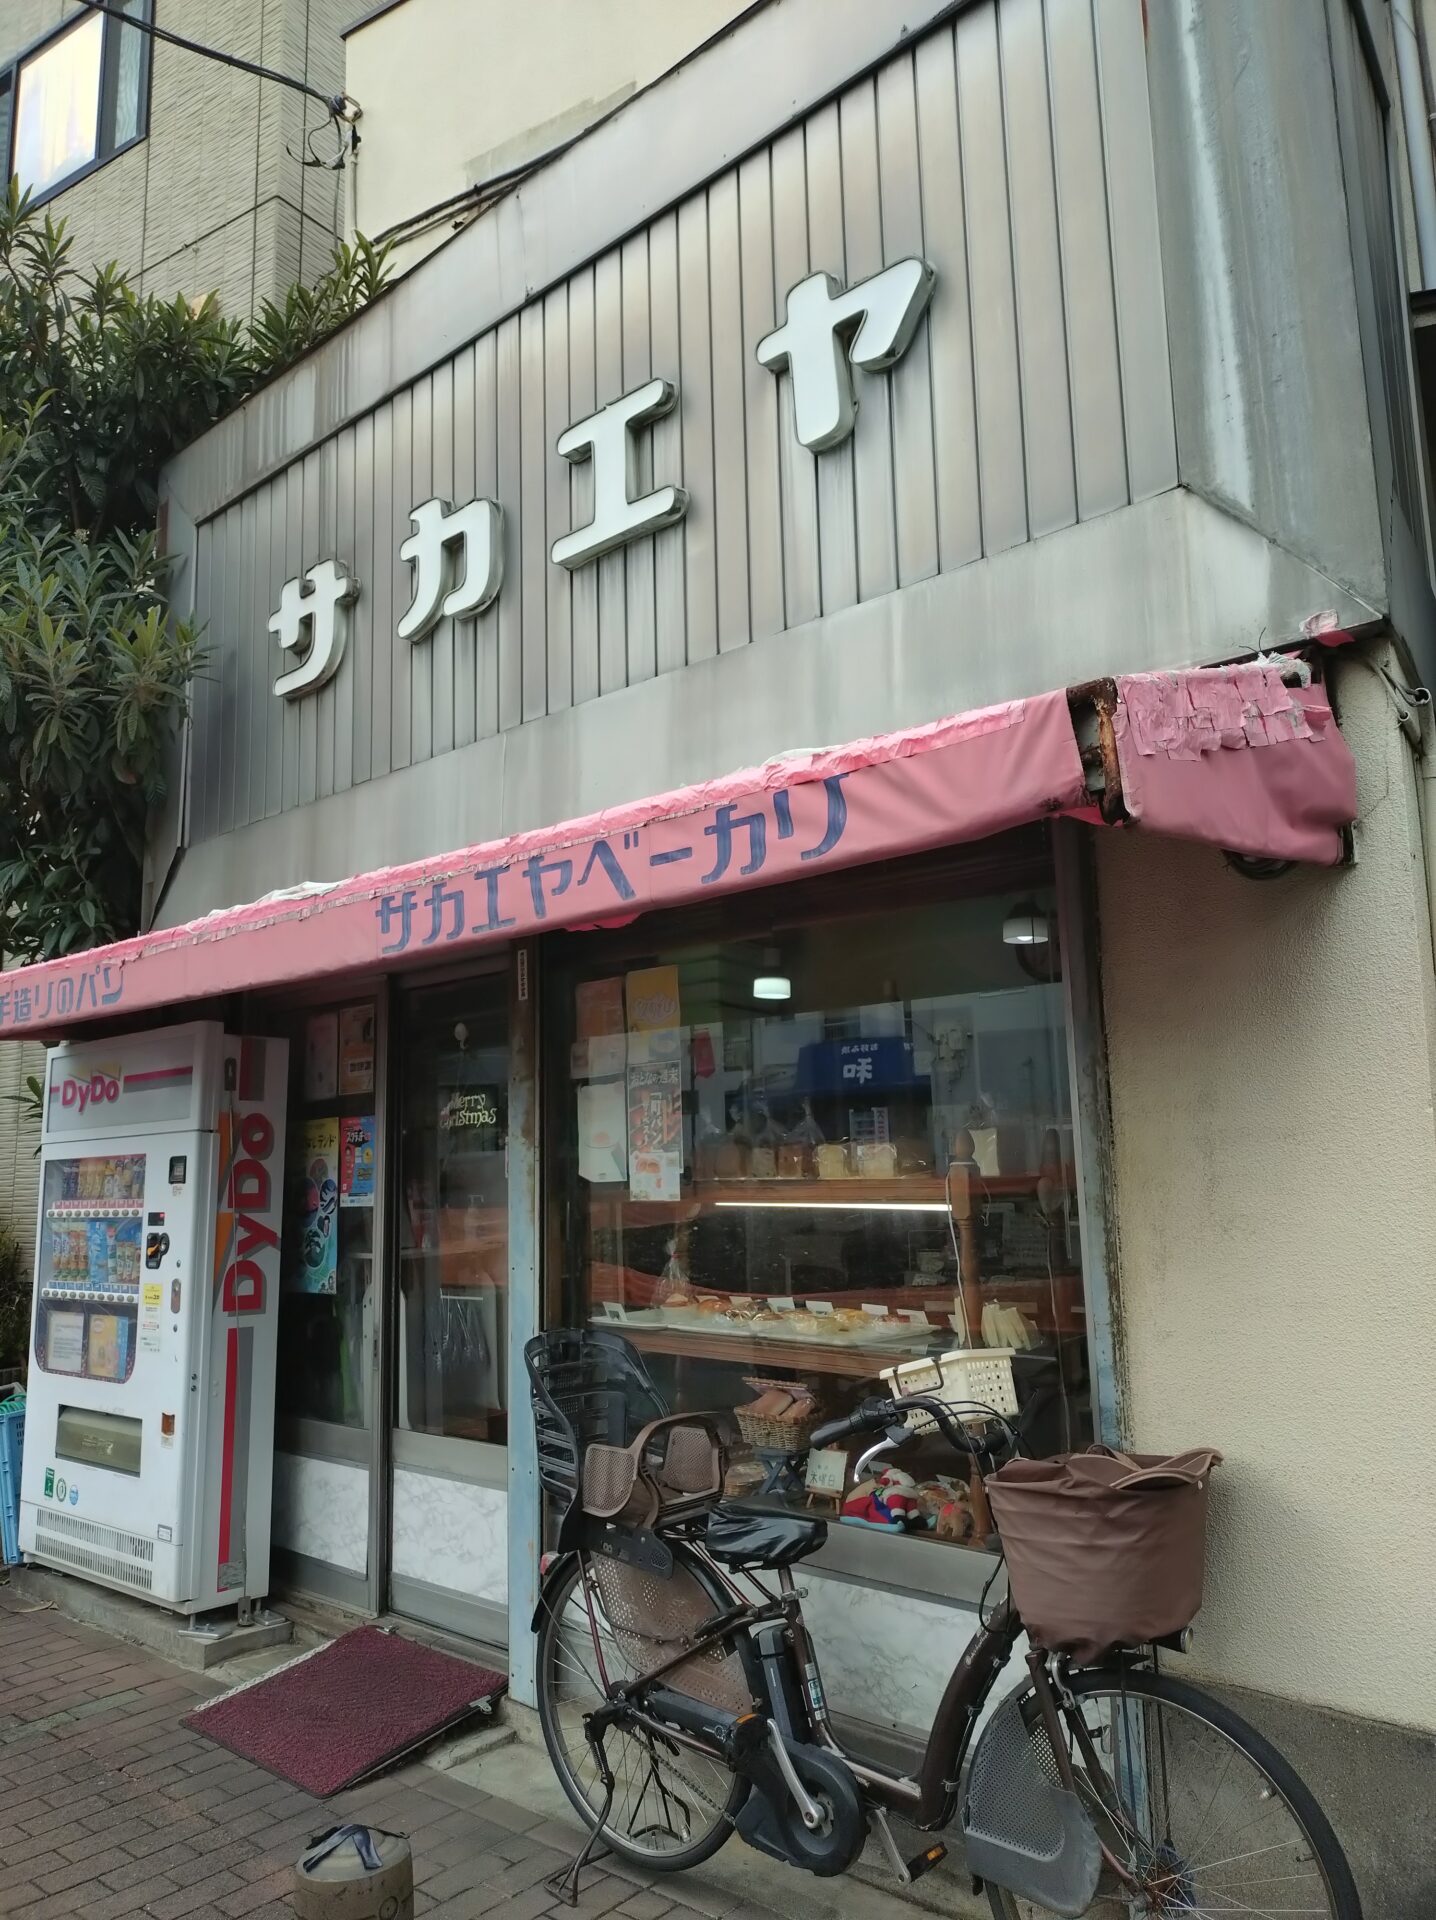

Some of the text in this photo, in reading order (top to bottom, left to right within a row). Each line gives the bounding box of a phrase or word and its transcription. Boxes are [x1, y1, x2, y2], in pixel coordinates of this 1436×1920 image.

[268, 255, 938, 699] サカエヤ
[376, 772, 849, 954] サカエヤベーカリ
[62, 1075, 120, 1112] DyDo
[223, 1112, 280, 1313] DyDo
